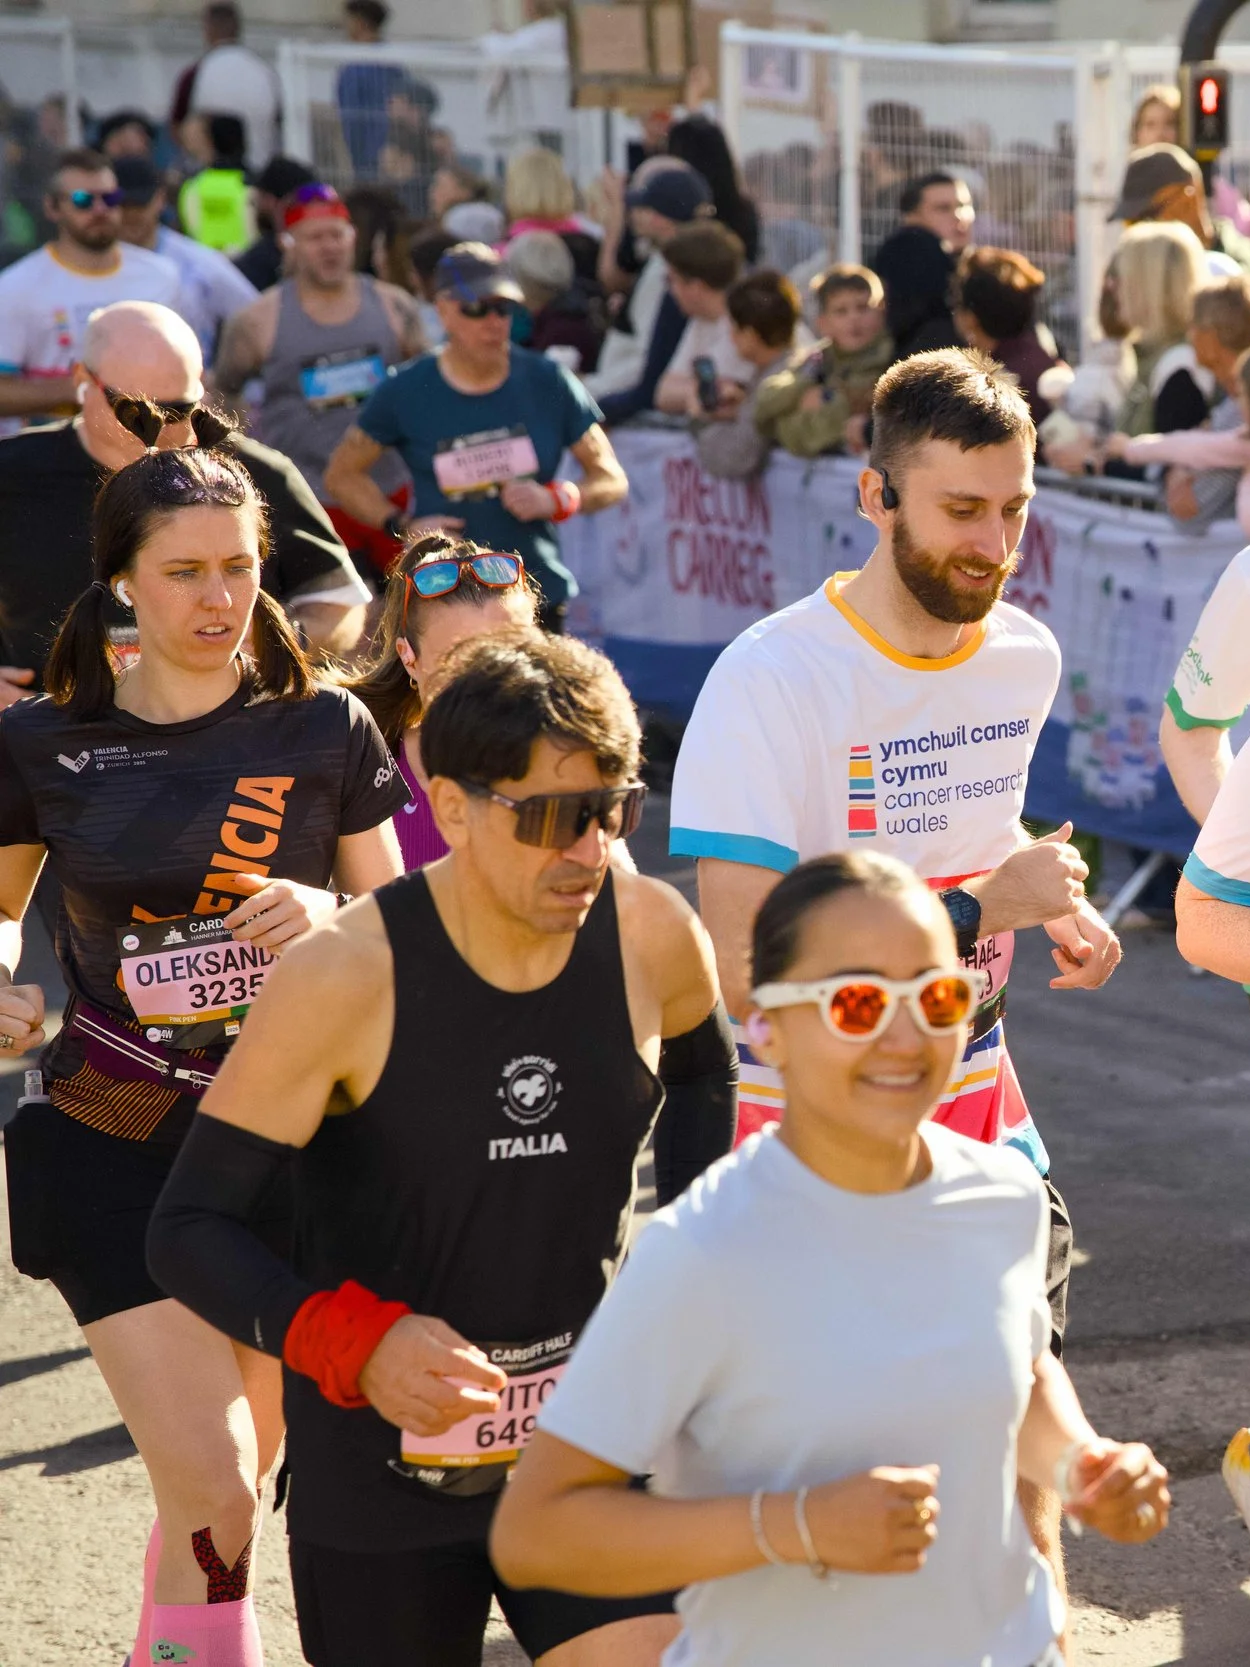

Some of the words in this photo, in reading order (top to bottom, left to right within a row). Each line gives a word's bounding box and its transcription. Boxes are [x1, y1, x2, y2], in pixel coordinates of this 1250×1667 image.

[93, 746, 128, 755] VALENCIA
[880, 725, 968, 762] ymchwil
[970, 718, 1030, 742] canser
[94, 753, 131, 762] TRINIDAD
[132, 749, 168, 759] ALFONSO
[881, 760, 947, 788] cymru
[884, 787, 952, 809] cancer
[955, 769, 1023, 800] research
[886, 813, 948, 835] wales
[192, 776, 295, 916] ENCIA
[189, 918, 225, 933] CARD
[191, 931, 214, 940] HANNER
[215, 928, 236, 936] MARAT
[136, 946, 275, 987] OLEKSAND
[160, 1028, 174, 1040] 4W
[488, 1132, 568, 1160] ITALIA
[491, 1343, 545, 1363] CARDIFF
[545, 1332, 573, 1352] HALF
[482, 1378, 556, 1412] ITO
[476, 1415, 537, 1448] 649
